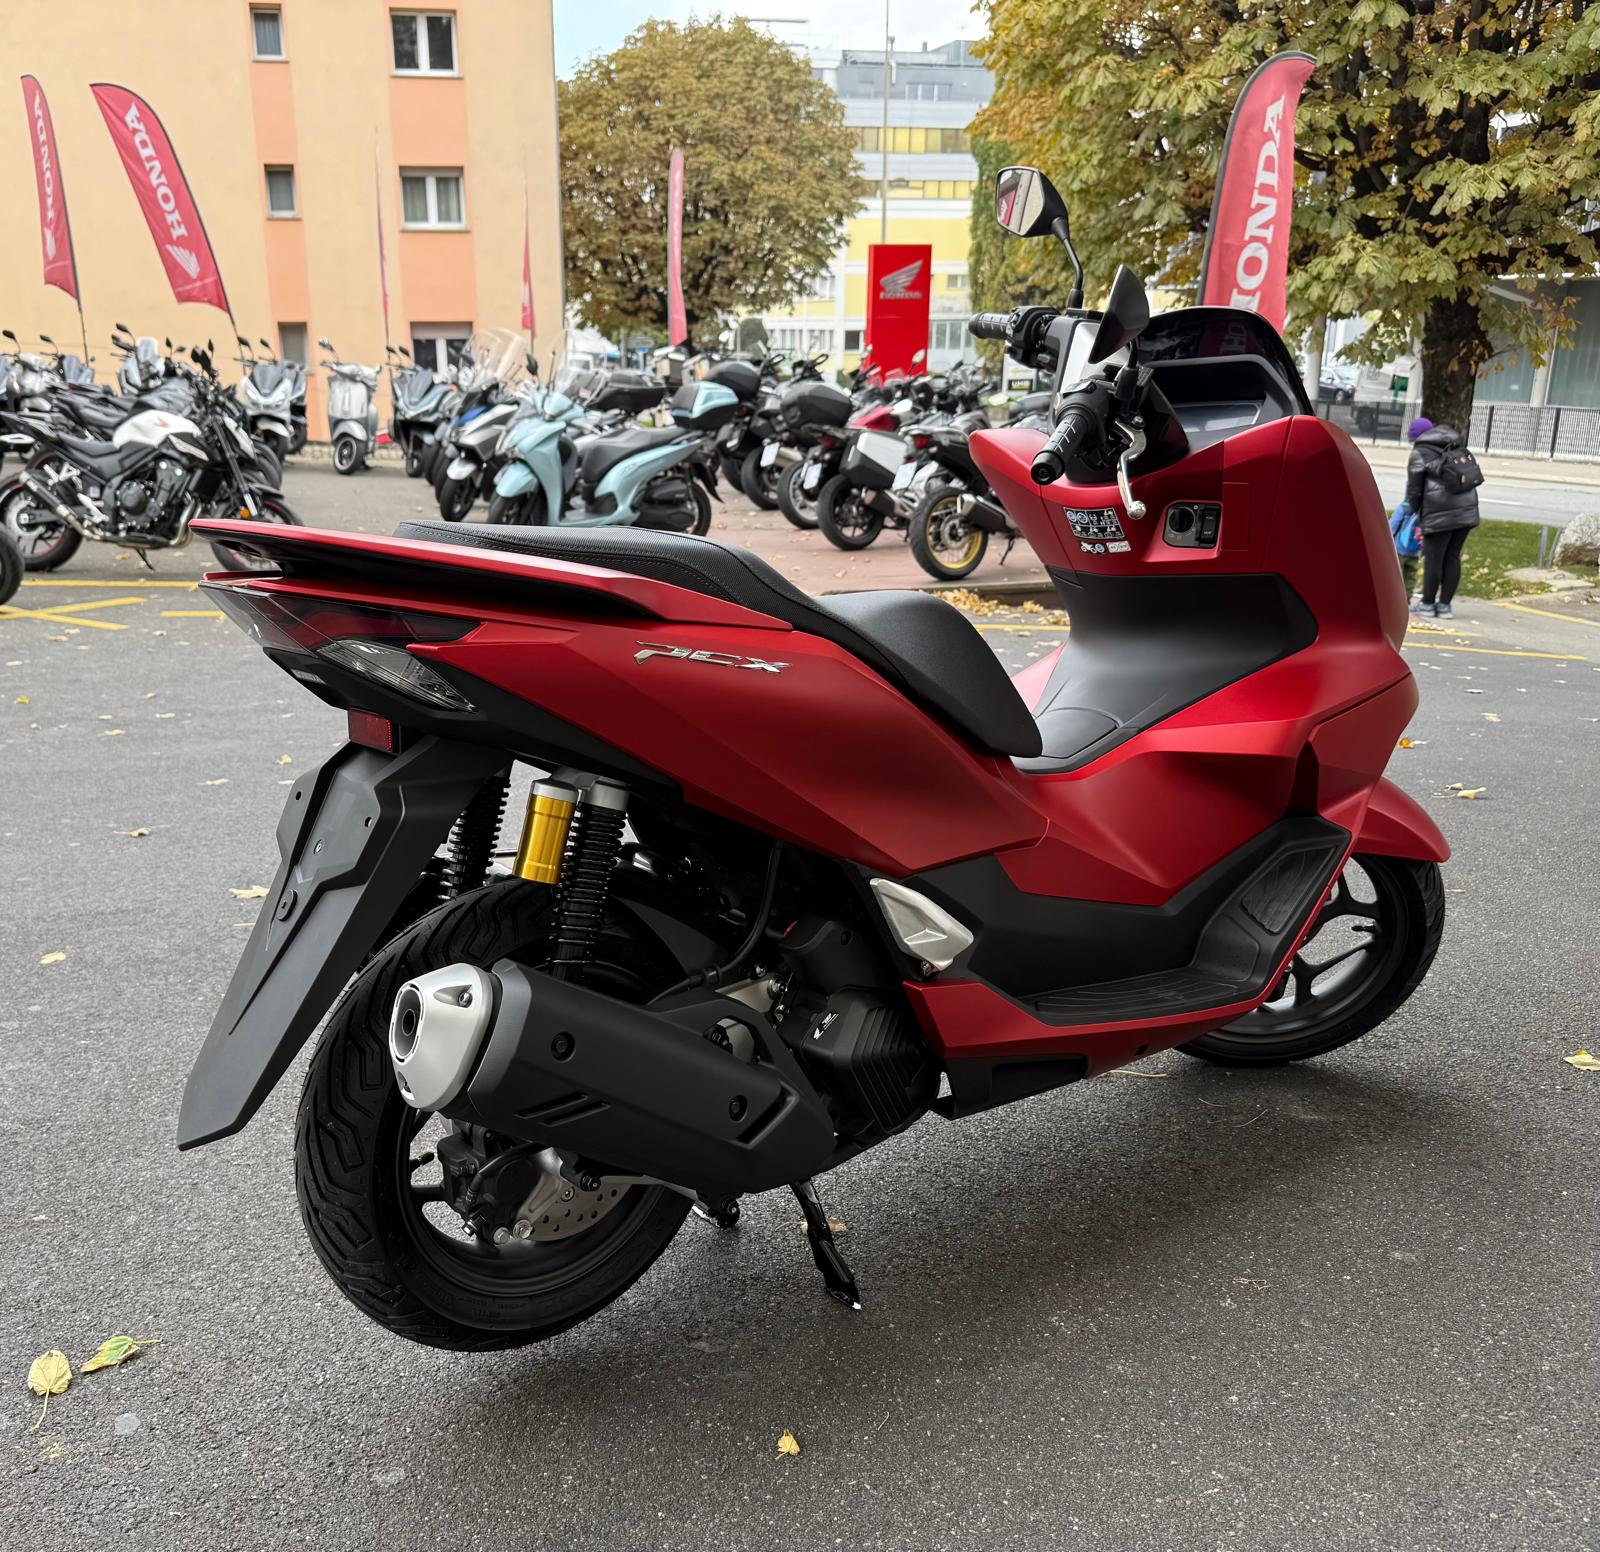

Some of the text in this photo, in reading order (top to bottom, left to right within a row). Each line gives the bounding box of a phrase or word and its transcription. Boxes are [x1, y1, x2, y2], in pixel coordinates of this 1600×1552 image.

[33, 90, 55, 220] HONDA
[124, 101, 188, 240] HONDA
[634, 640, 793, 673] PCX
